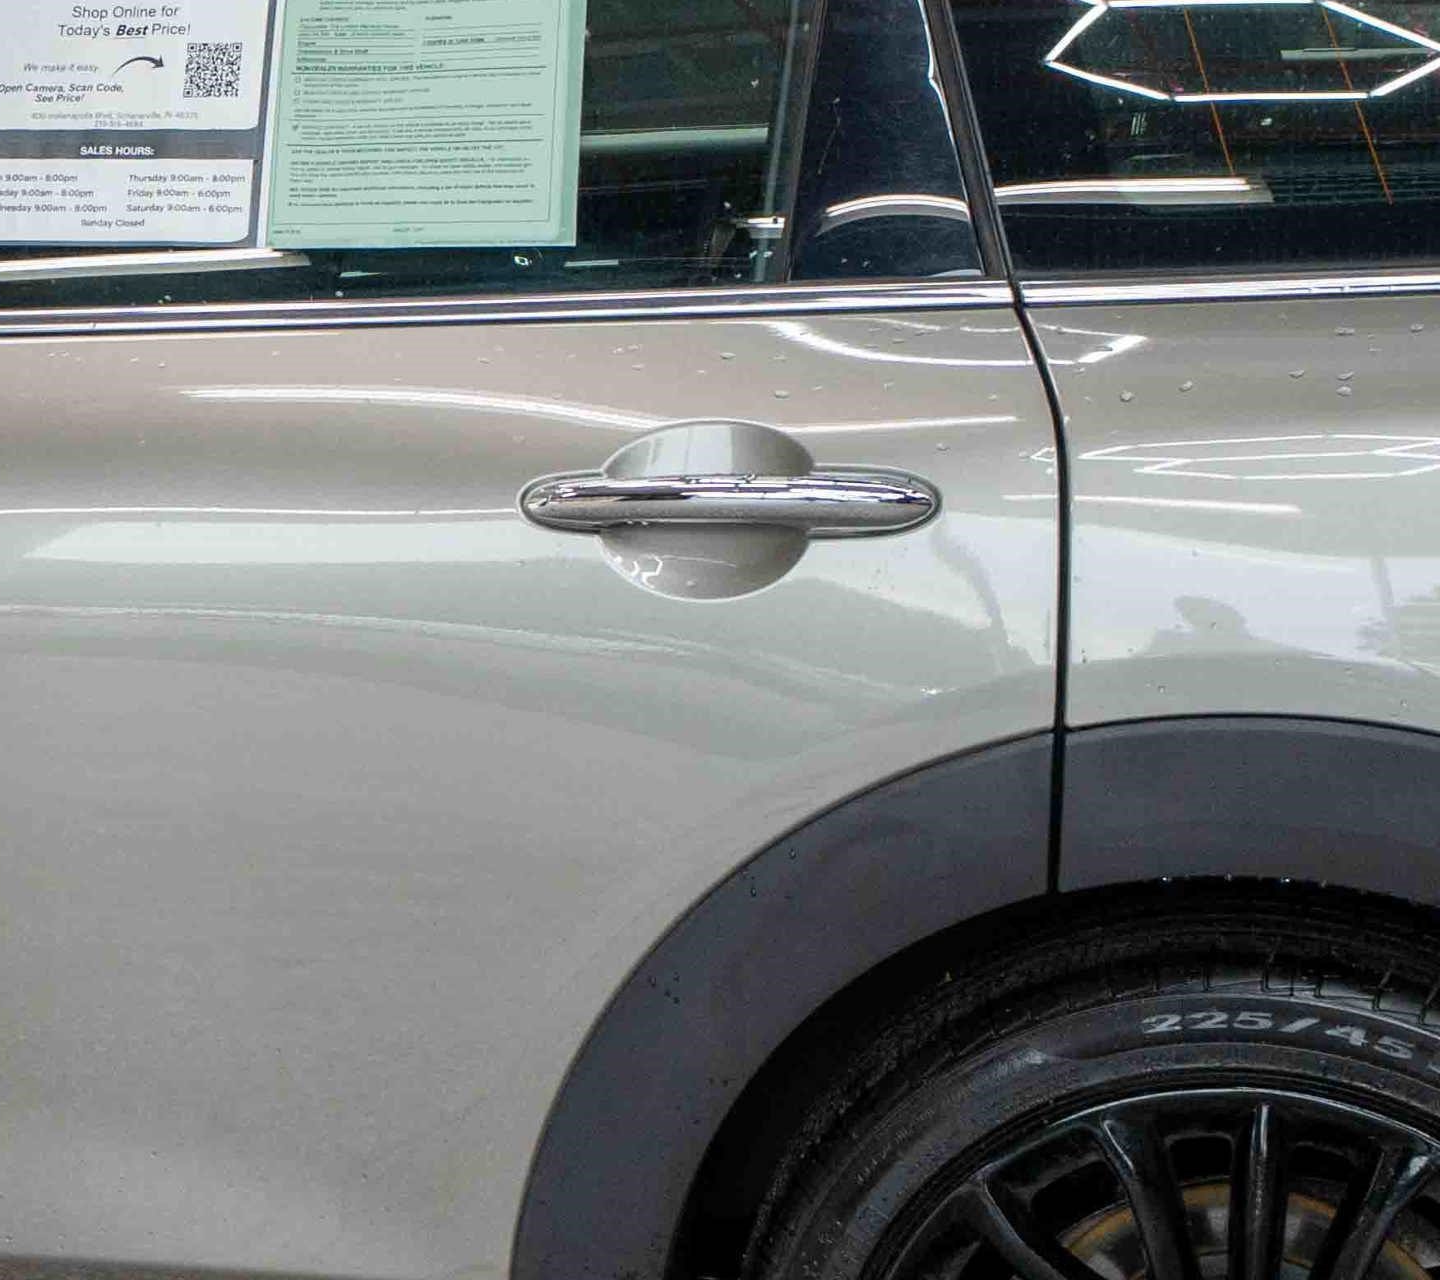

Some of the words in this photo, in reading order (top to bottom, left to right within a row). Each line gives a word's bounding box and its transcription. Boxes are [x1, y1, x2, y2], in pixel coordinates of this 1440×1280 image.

[71, 5, 109, 21] Shop
[112, 5, 158, 18] Online
[161, 4, 181, 18] for
[58, 23, 111, 39] Today's
[115, 24, 149, 37] Best
[151, 23, 192, 37] Price!
[68, 82, 94, 93] Scan
[34, 93, 54, 104] See
[80, 145, 113, 156] SALES
[115, 145, 156, 156] HOURS:
[129, 174, 168, 183] Thursday
[127, 188, 153, 198] Friday
[126, 203, 164, 213] Saturday
[80, 219, 114, 228] Sunday
[115, 218, 145, 228] Closed
[1140, 1009, 1417, 1061] 225/45
